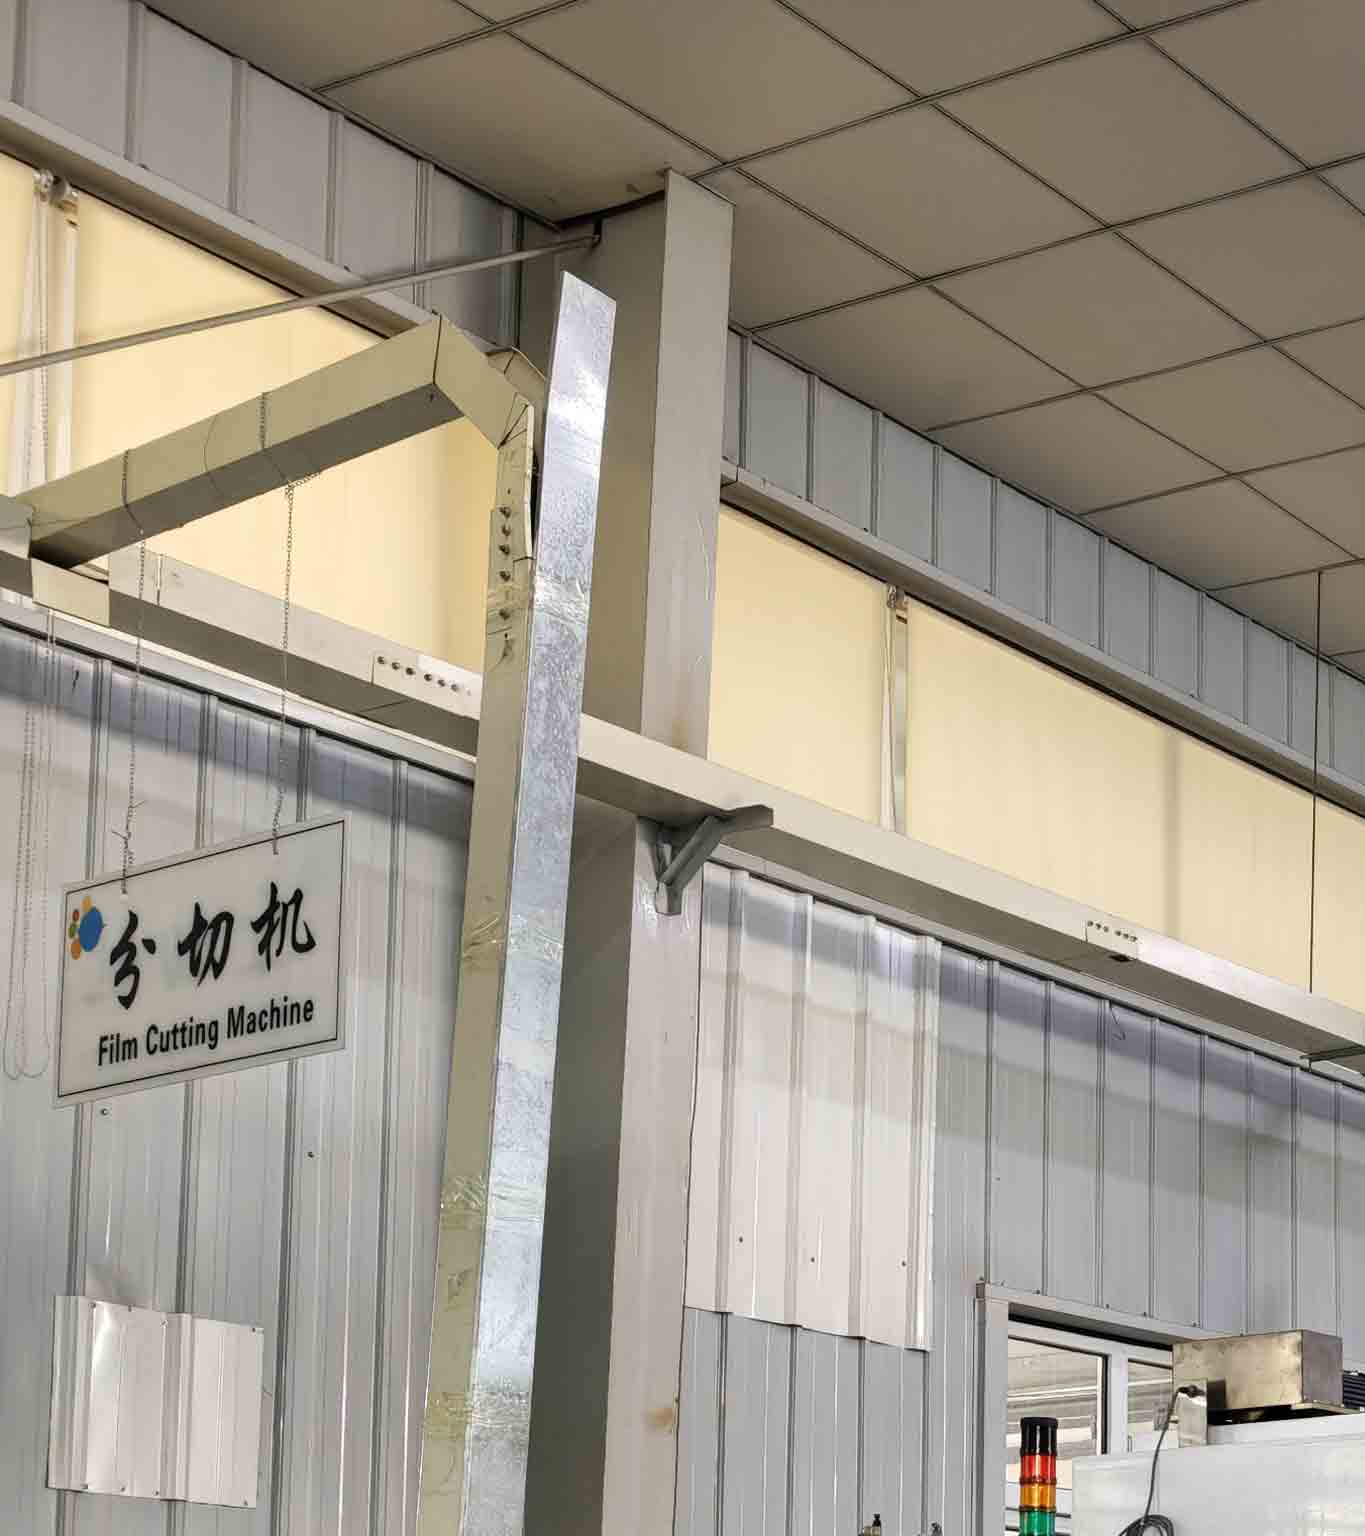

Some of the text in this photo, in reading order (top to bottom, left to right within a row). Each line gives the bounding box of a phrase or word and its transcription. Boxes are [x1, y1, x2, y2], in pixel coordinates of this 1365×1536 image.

[109, 881, 316, 1010] 分切机
[97, 998, 314, 1066] Film Cutting Machine
